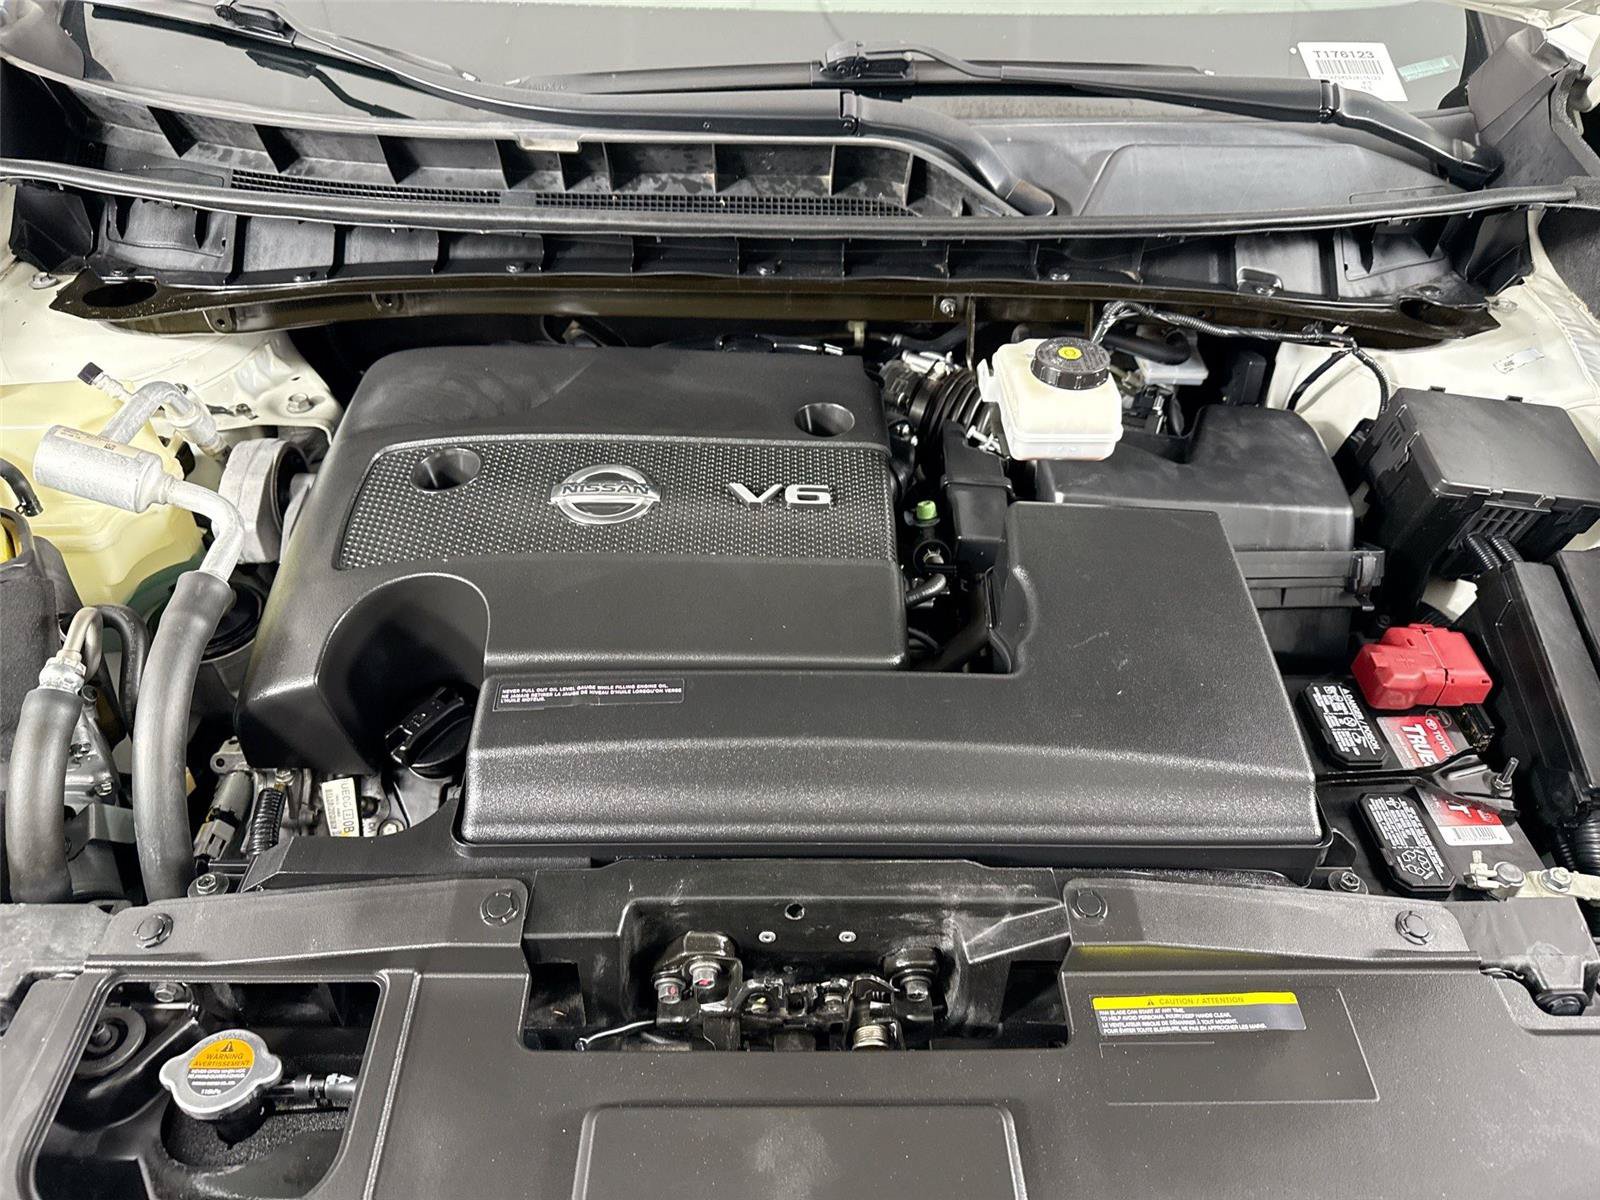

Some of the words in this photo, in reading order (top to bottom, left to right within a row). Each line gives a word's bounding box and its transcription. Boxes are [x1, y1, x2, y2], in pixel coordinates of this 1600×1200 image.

[562, 483, 649, 495] NISSAN
[728, 482, 832, 507] V6
[1433, 729, 1454, 757] TOYOT
[1158, 998, 1194, 1006] CAUTION
[1201, 997, 1244, 1005] ATTENTION
